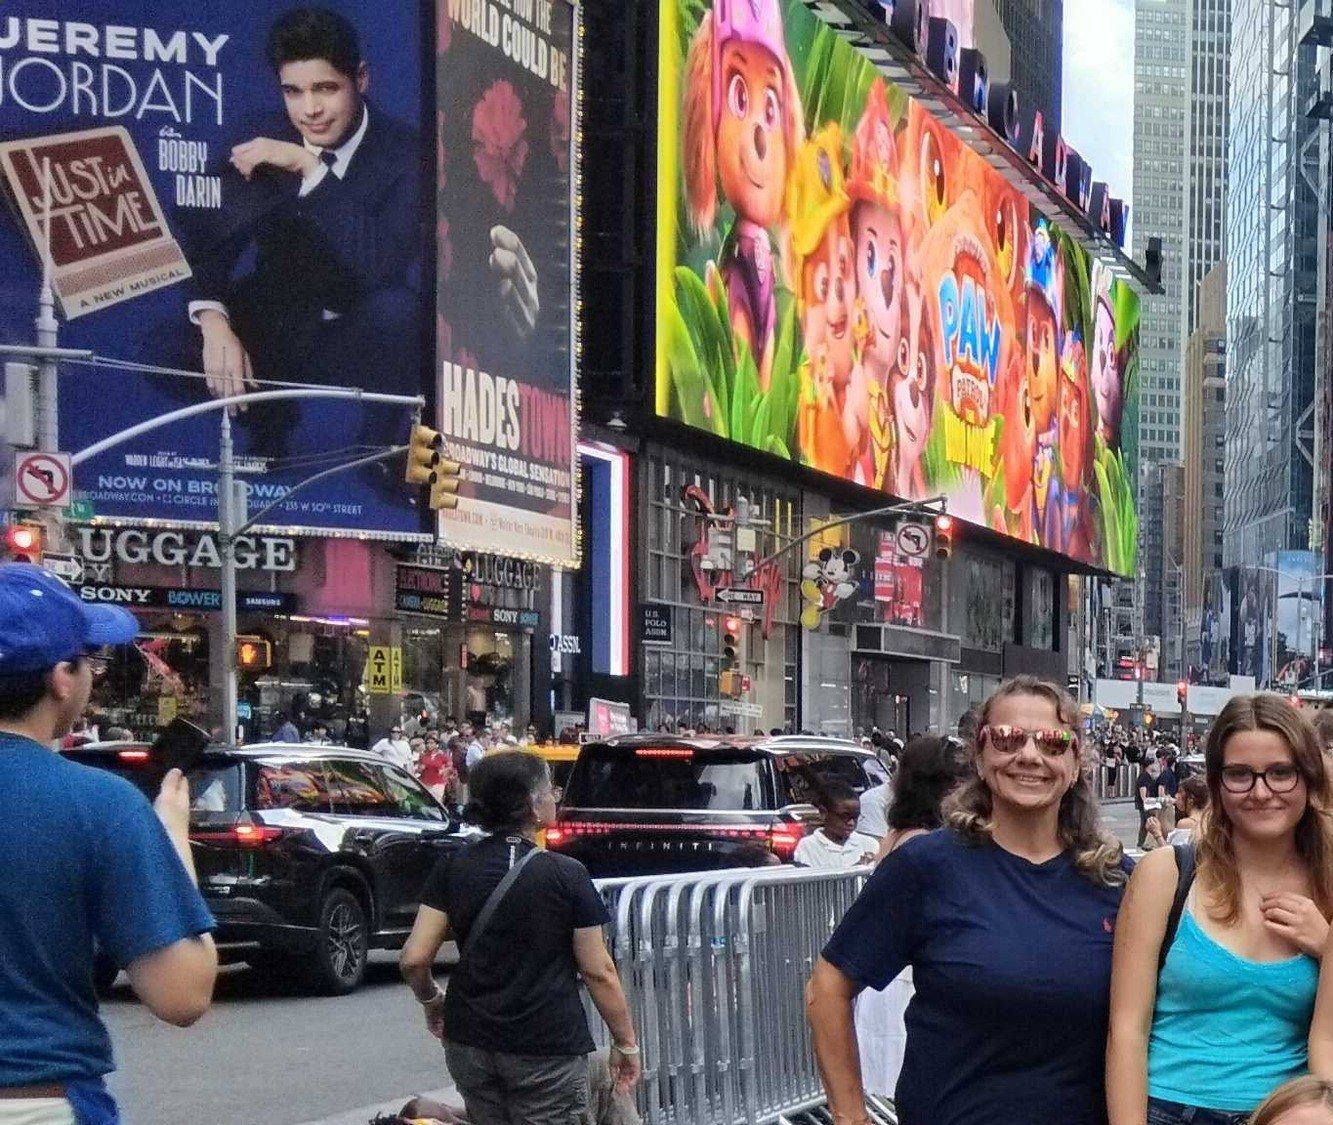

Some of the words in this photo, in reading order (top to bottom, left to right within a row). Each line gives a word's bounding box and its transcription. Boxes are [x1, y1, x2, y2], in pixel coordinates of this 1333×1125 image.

[0, 17, 229, 65] JEREMY
[502, 14, 547, 79] COULD
[550, 46, 566, 92] BE
[158, 138, 208, 173] BOBBY
[107, 163, 132, 188] in
[176, 174, 221, 209] DARIN
[79, 298, 90, 307] A
[93, 286, 126, 304] NEW
[129, 267, 186, 293] MUSICAL
[938, 271, 1002, 391] PAW
[443, 361, 570, 468] HADESTOWN
[99, 474, 148, 491] NOW
[154, 478, 182, 493] ON
[499, 453, 528, 479] GLOBAL
[333, 503, 363, 516] STREET
[78, 526, 296, 571] UGGAGE
[475, 552, 541, 591] LUGGAGE
[81, 585, 151, 602] SONY
[494, 608, 518, 624] SONY
[645, 619, 667, 627] POLO
[373, 649, 386, 686] ATM
[608, 842, 713, 851] INFINITI
